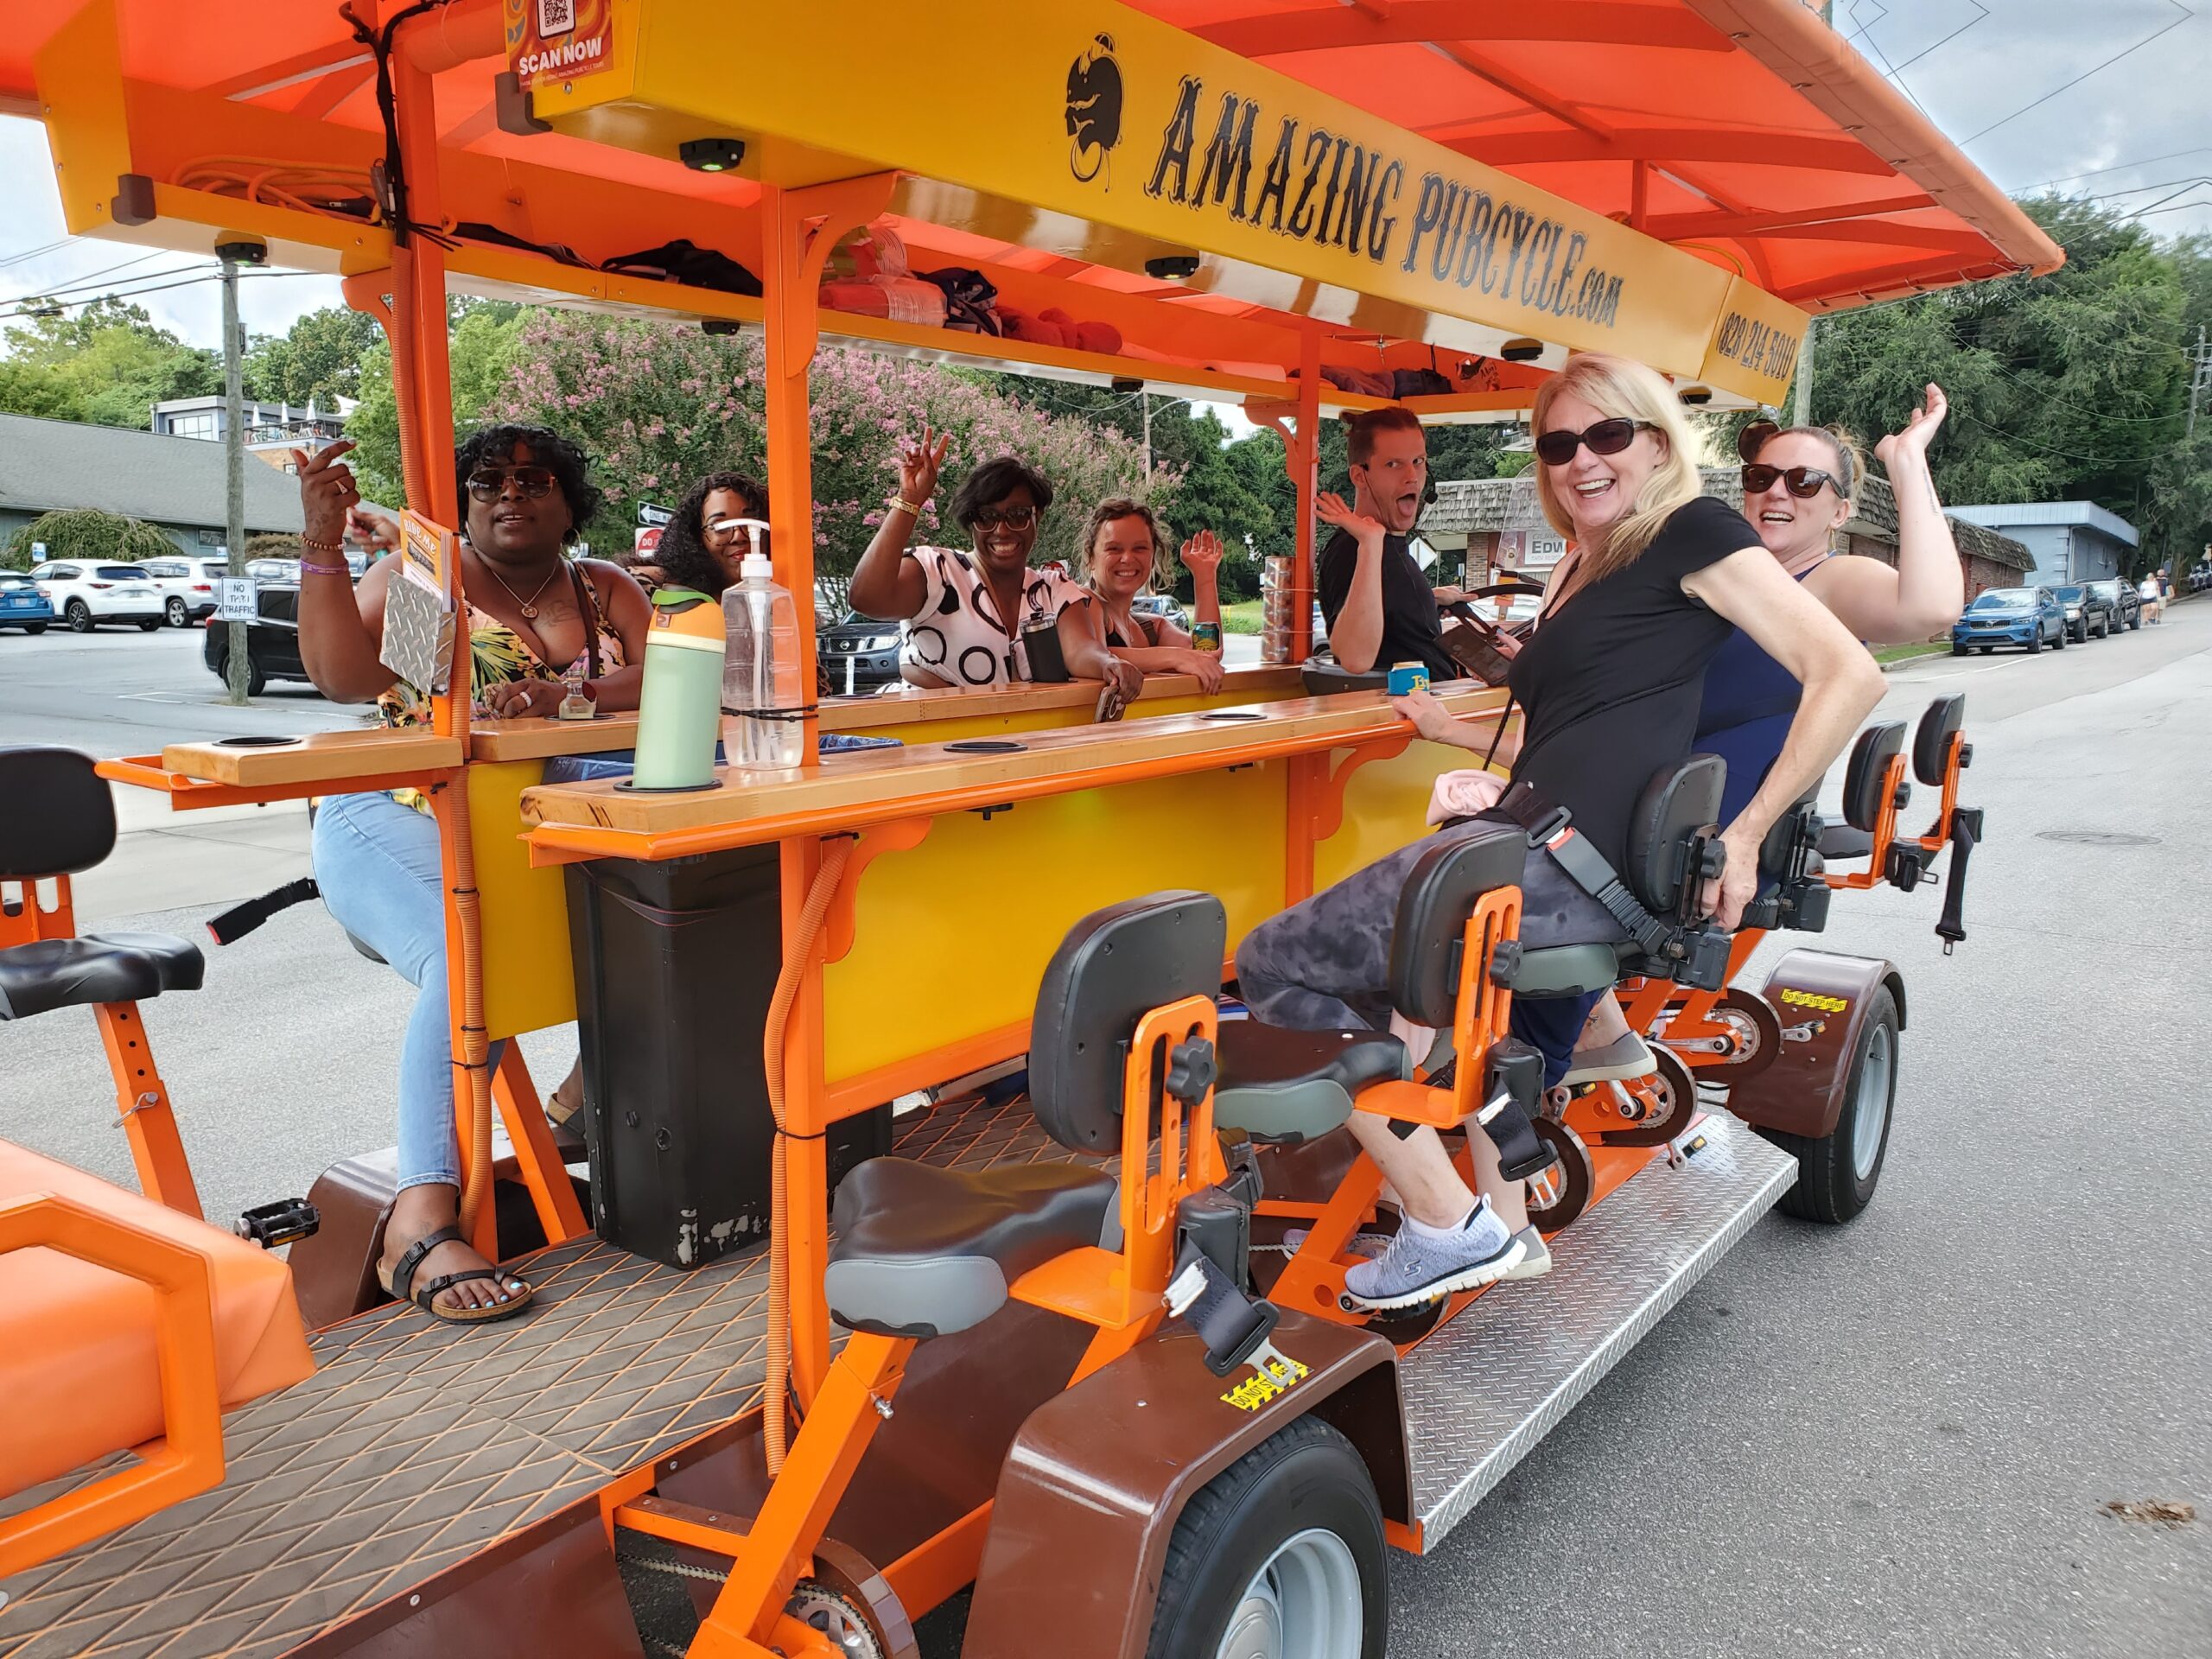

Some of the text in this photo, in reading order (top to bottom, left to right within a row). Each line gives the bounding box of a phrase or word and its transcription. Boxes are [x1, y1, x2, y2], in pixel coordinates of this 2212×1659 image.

[519, 36, 602, 76] SCAN NOW
[1144, 74, 1407, 264] AMAZING
[1740, 319, 1771, 372] 214
[1764, 330, 1796, 382] 5010
[642, 537, 653, 546] DO
[233, 584, 245, 593] NO
[1808, 997, 1826, 1006] STEP
[1825, 1000, 1844, 1009] HERE
[1233, 1395, 1251, 1407] DO
[1243, 1384, 1267, 1399] NOT
